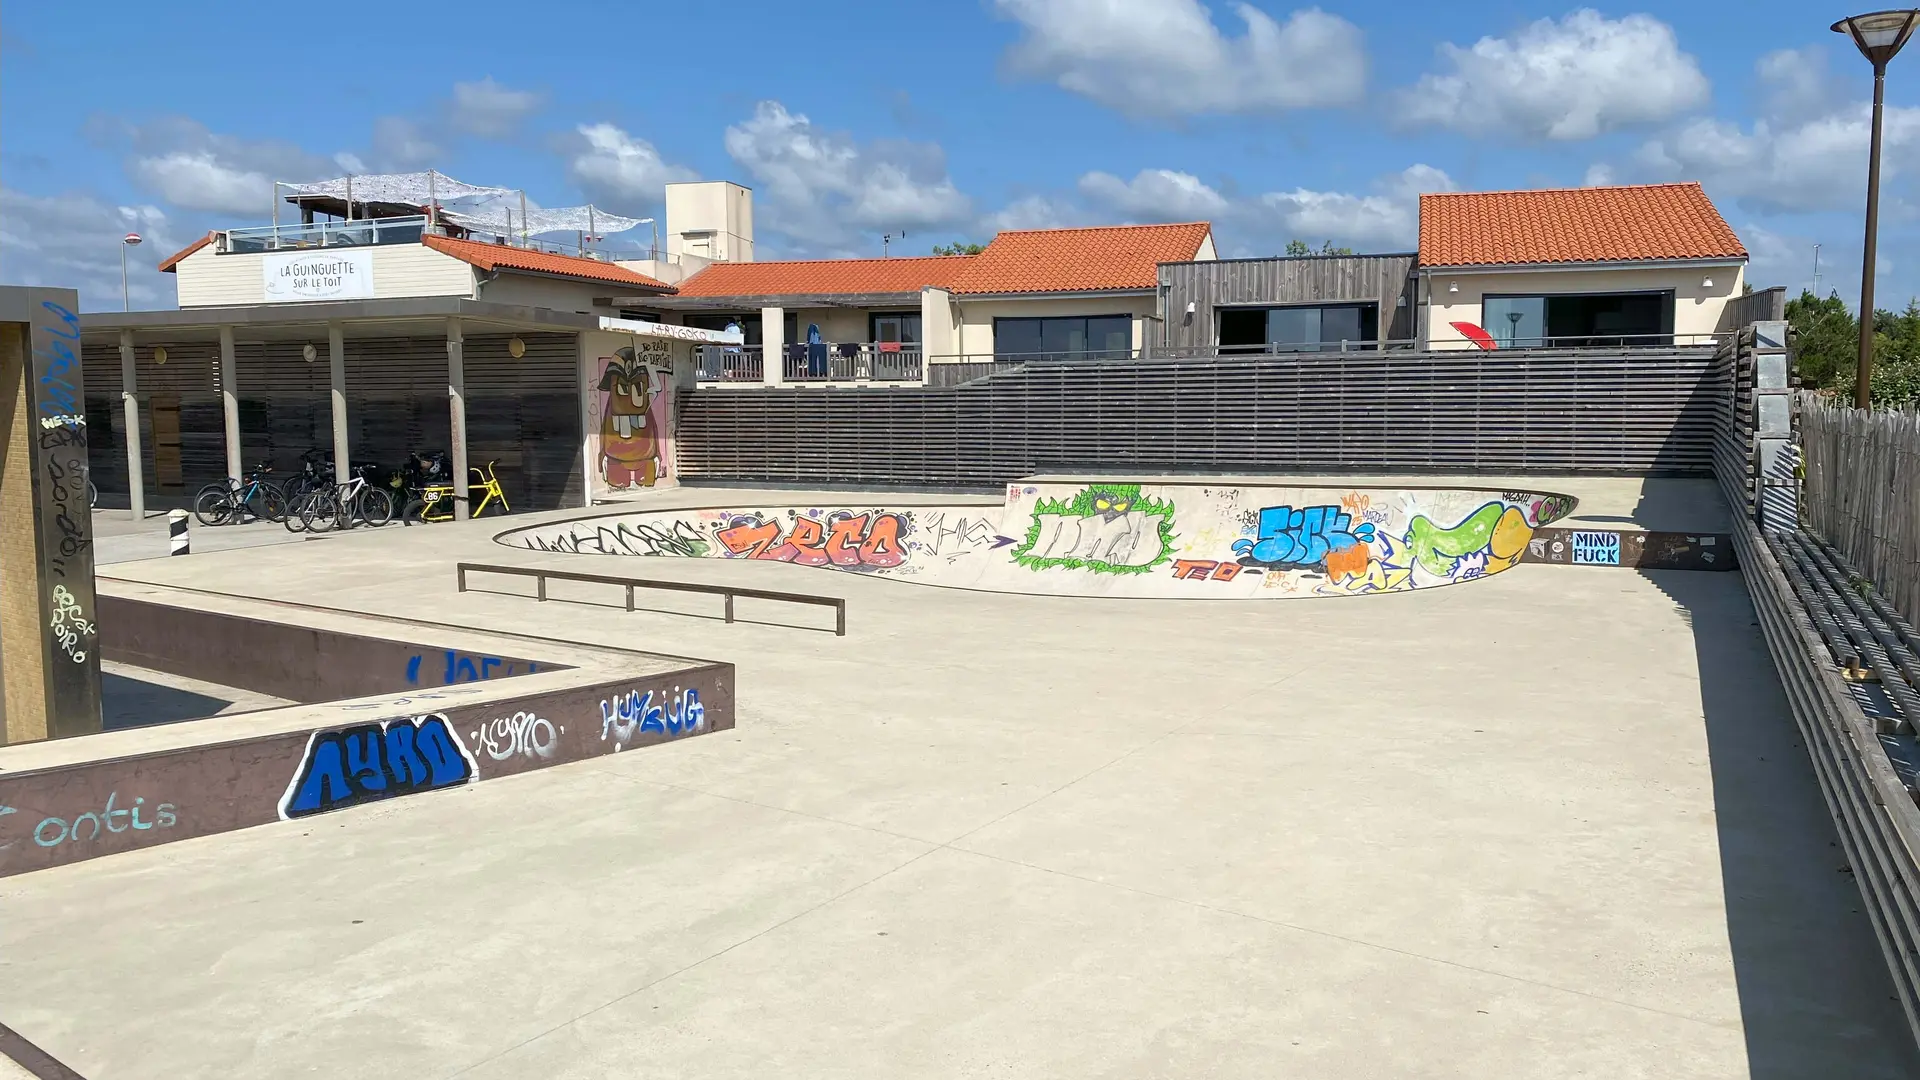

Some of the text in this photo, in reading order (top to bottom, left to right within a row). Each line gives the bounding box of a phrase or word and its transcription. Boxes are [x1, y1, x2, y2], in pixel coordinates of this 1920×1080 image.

[280, 262, 355, 277] LA GUINGUETTE
[293, 276, 342, 288] SUR LE TOIT
[427, 491, 439, 500] 86
[1575, 533, 1617, 548] MIND
[1573, 548, 1618, 563] FUCK
